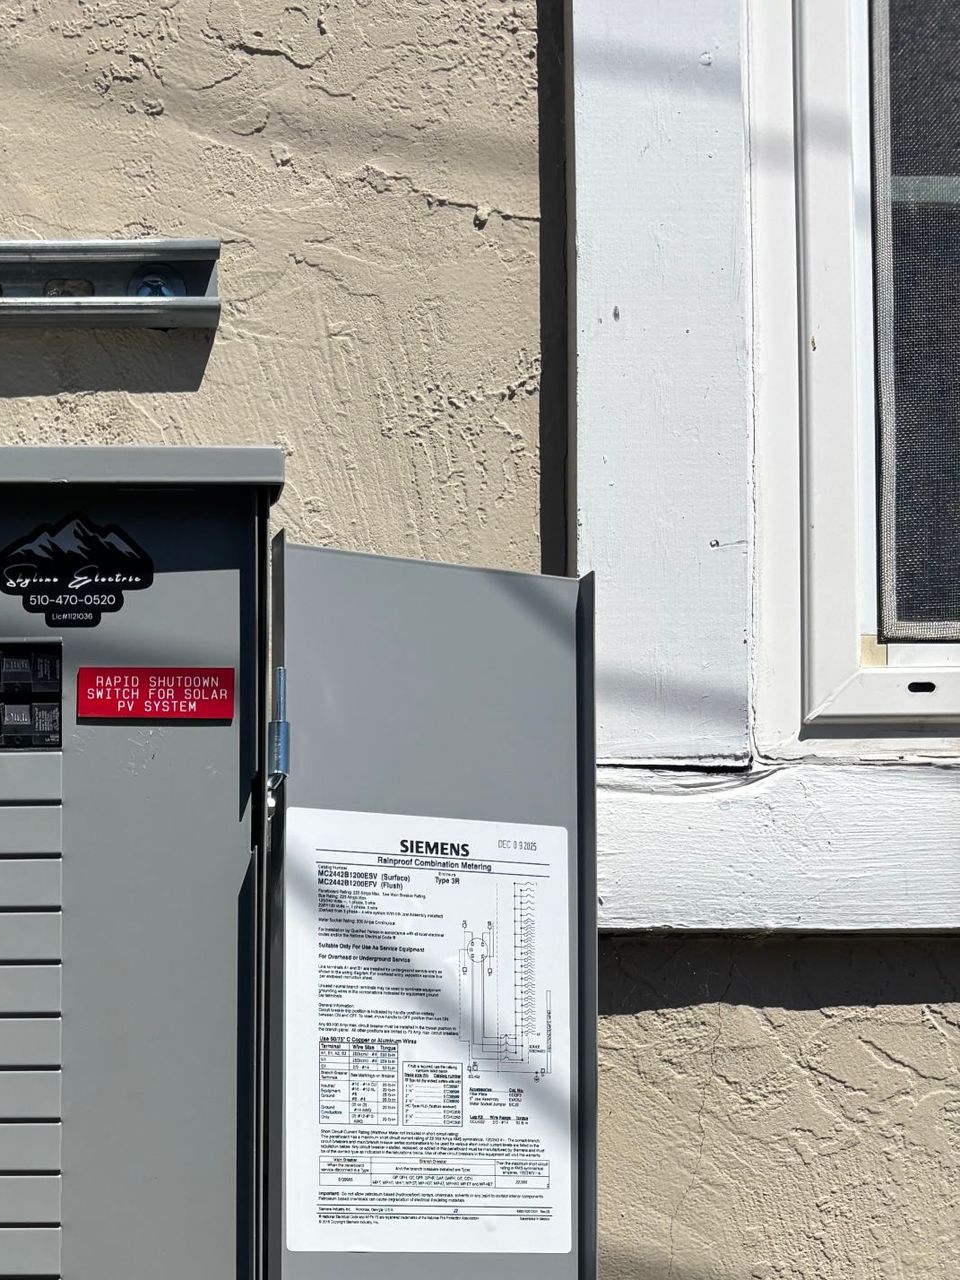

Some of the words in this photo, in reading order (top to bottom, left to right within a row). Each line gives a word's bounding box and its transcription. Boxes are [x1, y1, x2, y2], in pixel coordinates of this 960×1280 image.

[68, 565, 141, 589] Electric
[29, 594, 116, 606] 510-470-0520
[96, 676, 140, 687] RAPID
[149, 676, 219, 688] SHUTDOWN
[87, 688, 140, 700] SWITCH
[148, 688, 174, 700] FOR
[184, 688, 228, 700] SOLAR
[117, 700, 135, 712] PV
[144, 700, 197, 712] SYSTEM
[400, 839, 470, 857] SIEMENS
[498, 840, 511, 848] DEC
[378, 856, 412, 866] Rainproof
[414, 858, 460, 868] Combination
[461, 862, 492, 872] Metering
[381, 874, 410, 882] (Surface)
[435, 876, 450, 885] Type
[381, 882, 403, 890] (Flush)
